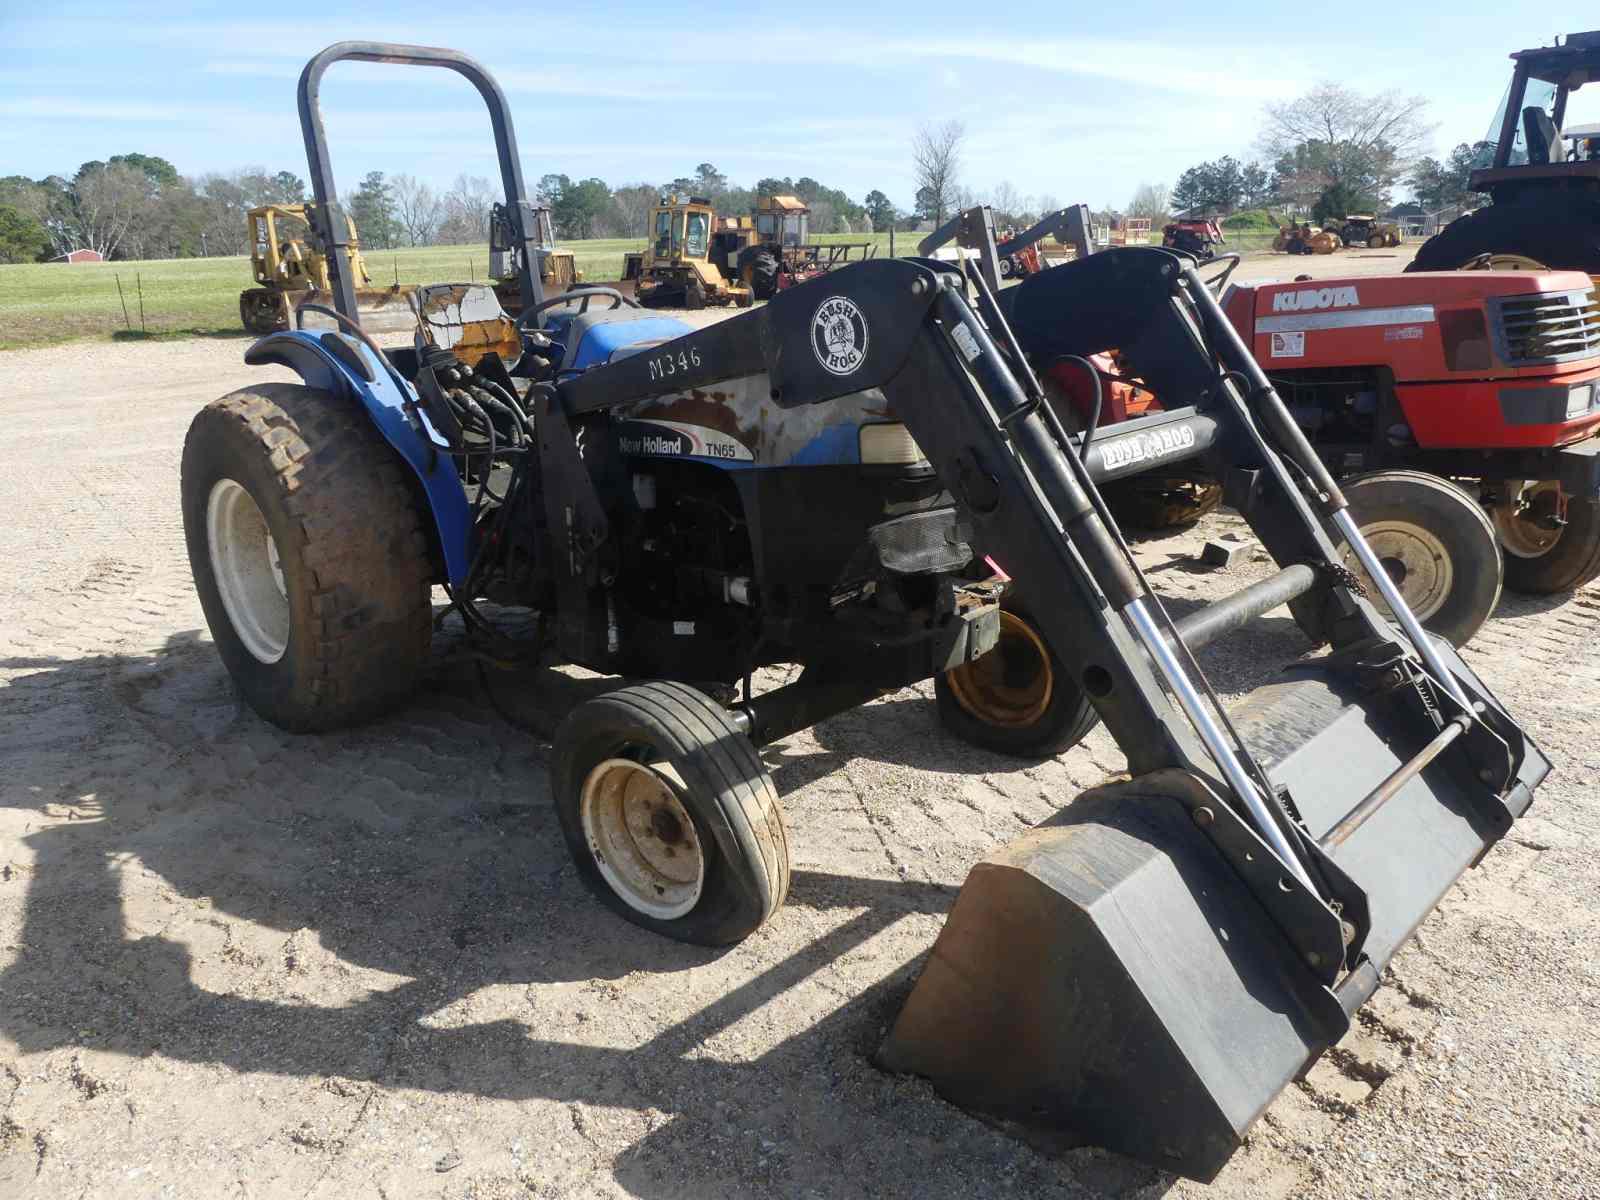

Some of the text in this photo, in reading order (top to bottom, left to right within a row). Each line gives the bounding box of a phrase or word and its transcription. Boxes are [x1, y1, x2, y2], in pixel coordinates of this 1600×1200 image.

[1273, 286, 1360, 311] KUBOTA
[819, 302, 855, 321] BUSH
[649, 347, 701, 381] M346
[829, 352, 858, 368] HOG
[620, 437, 681, 455] New Holland
[706, 443, 736, 457] TN65
